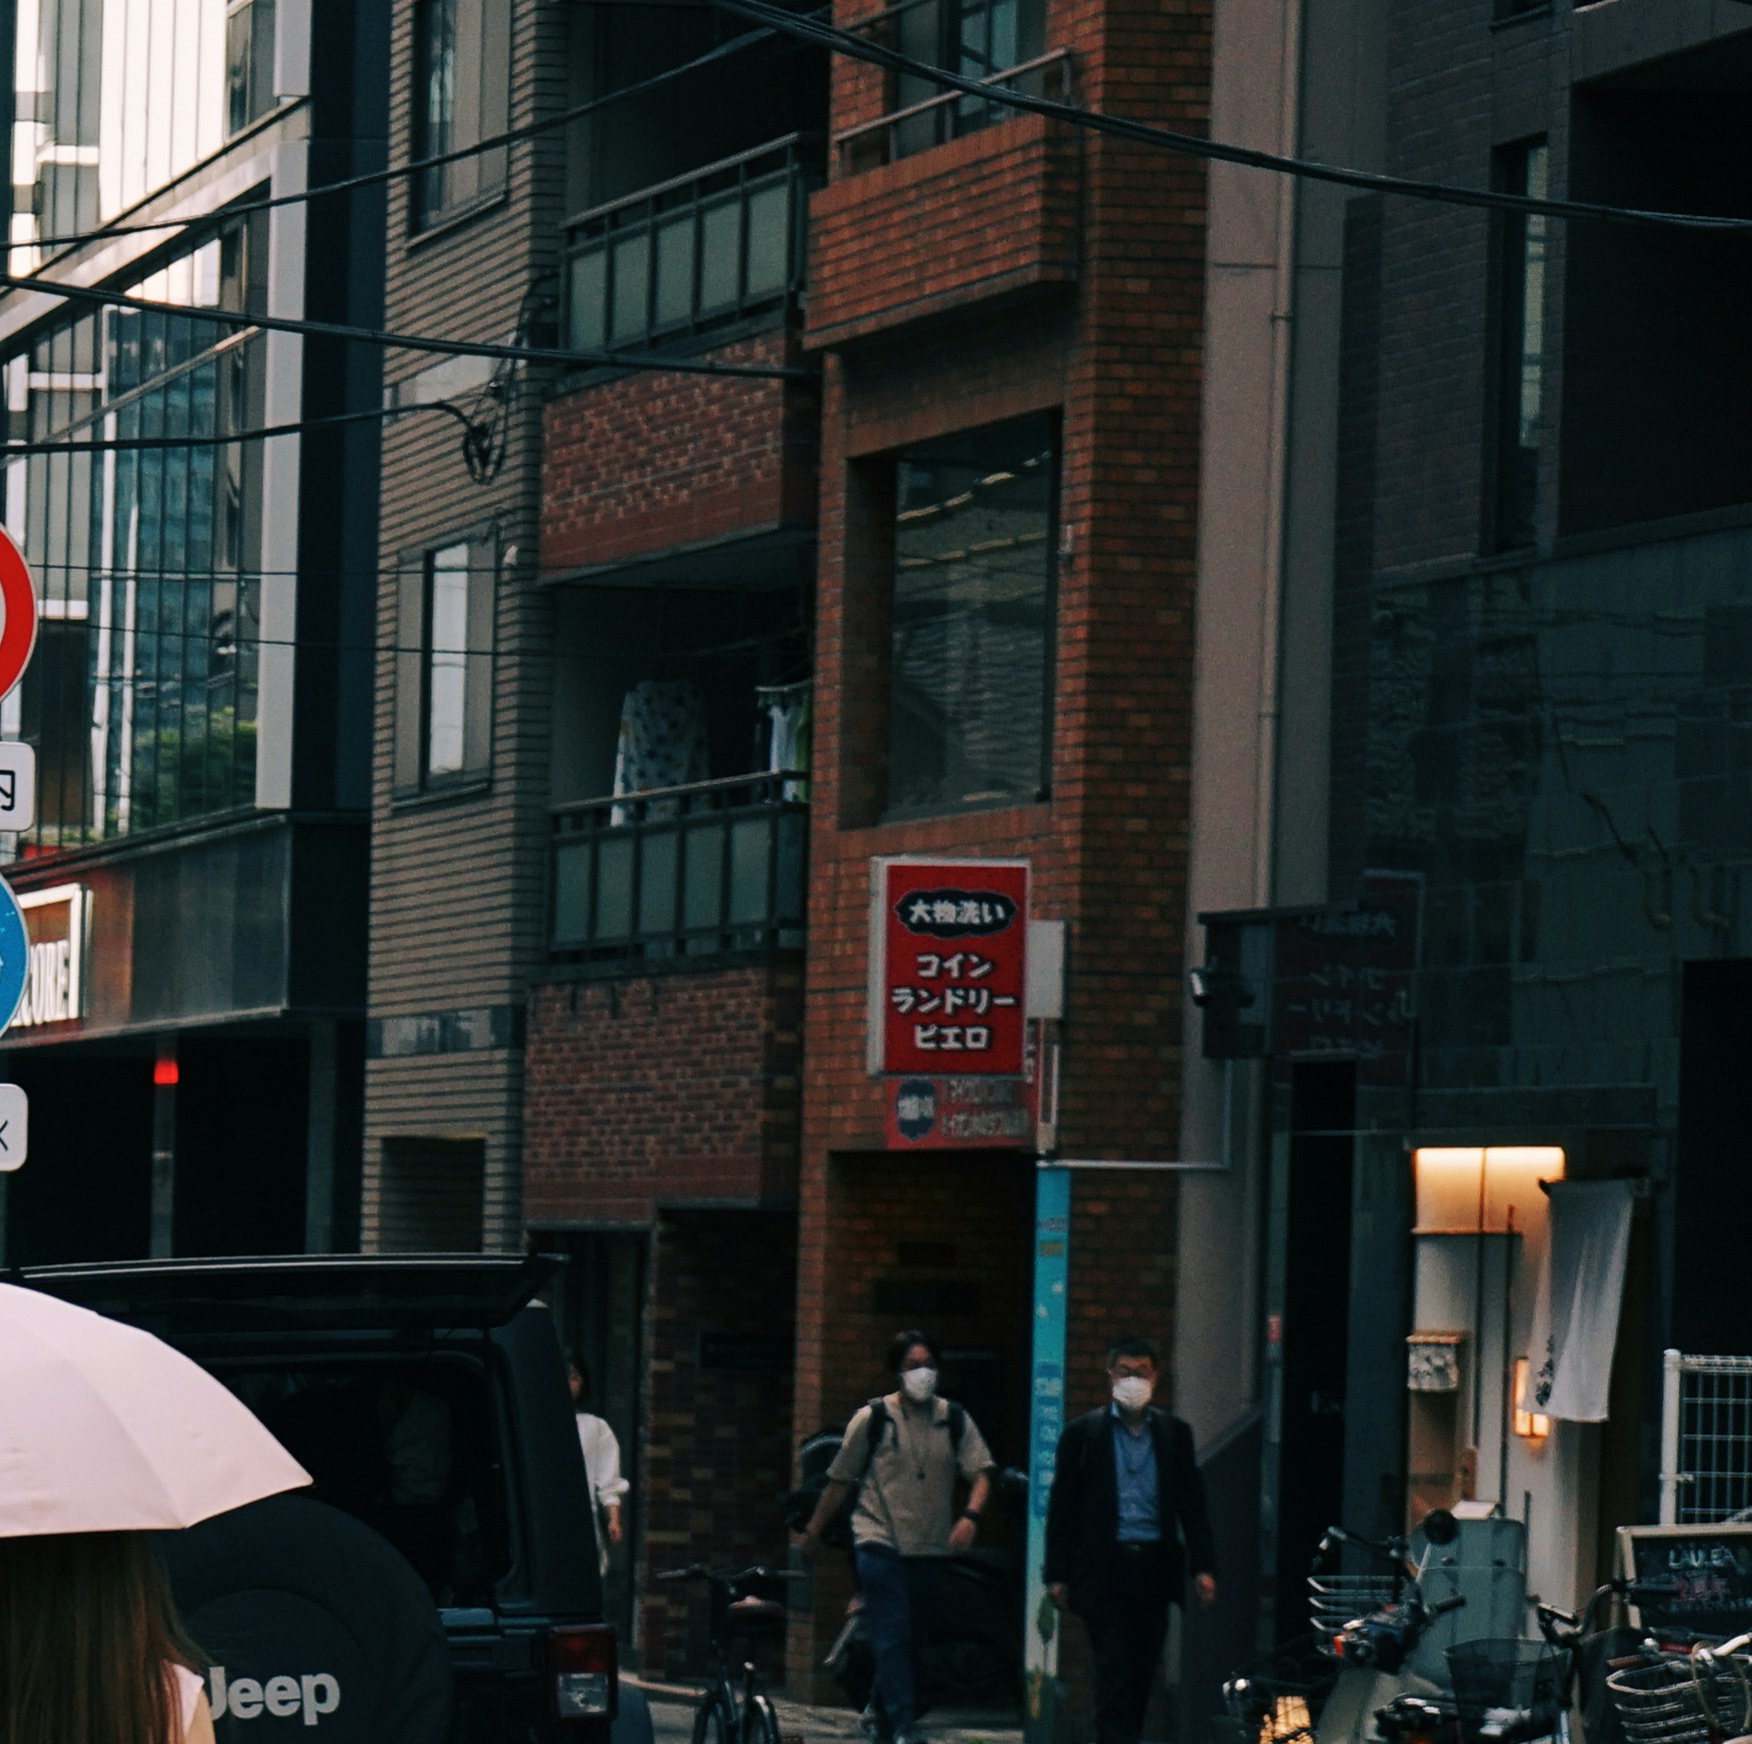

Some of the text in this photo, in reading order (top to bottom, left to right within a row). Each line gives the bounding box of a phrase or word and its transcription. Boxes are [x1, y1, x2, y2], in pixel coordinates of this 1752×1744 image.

[909, 900, 1005, 925] 大物洗い
[916, 953, 994, 979] コイン
[892, 987, 1016, 1015] ランドリー
[914, 1024, 989, 1050] ピエロ
[210, 1666, 340, 1726] Jeep
